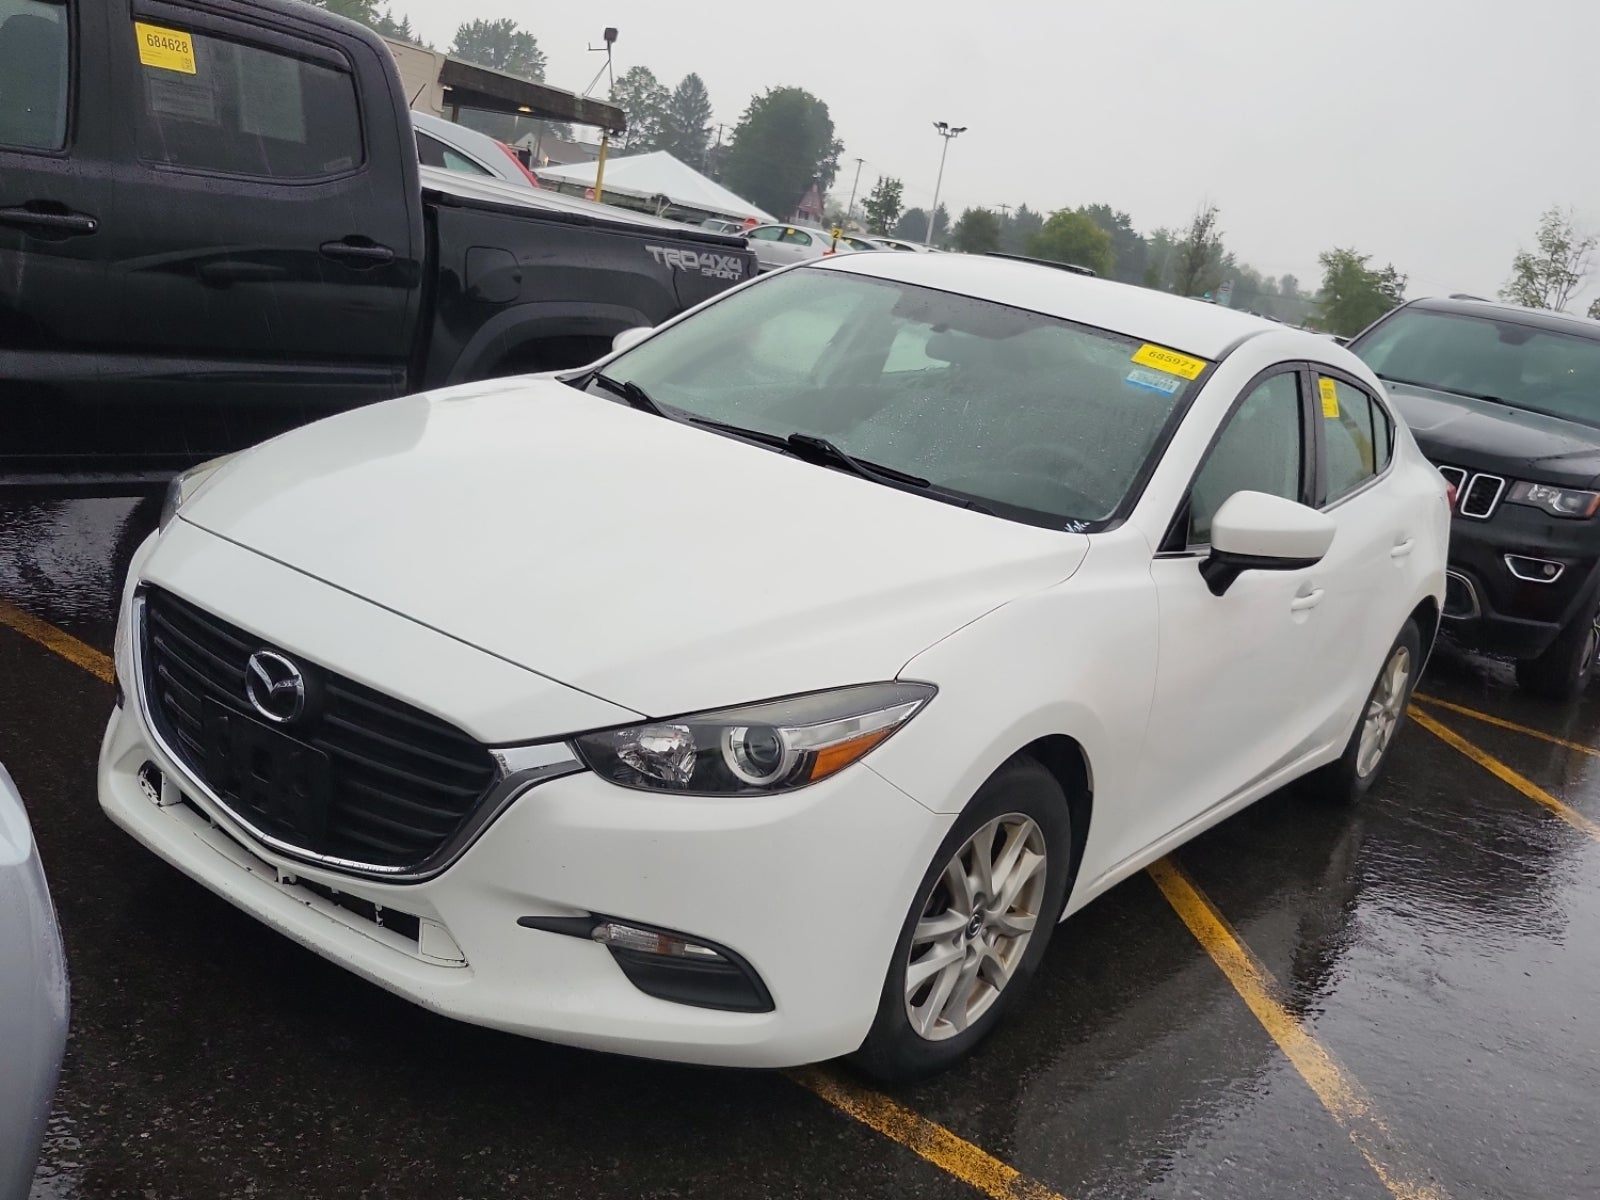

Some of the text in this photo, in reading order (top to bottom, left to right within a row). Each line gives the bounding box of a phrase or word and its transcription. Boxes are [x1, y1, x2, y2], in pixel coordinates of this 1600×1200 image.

[146, 33, 189, 54] 684628
[833, 229, 840, 239] 2
[701, 268, 742, 281] SPORT
[1148, 351, 1197, 370] 685971
